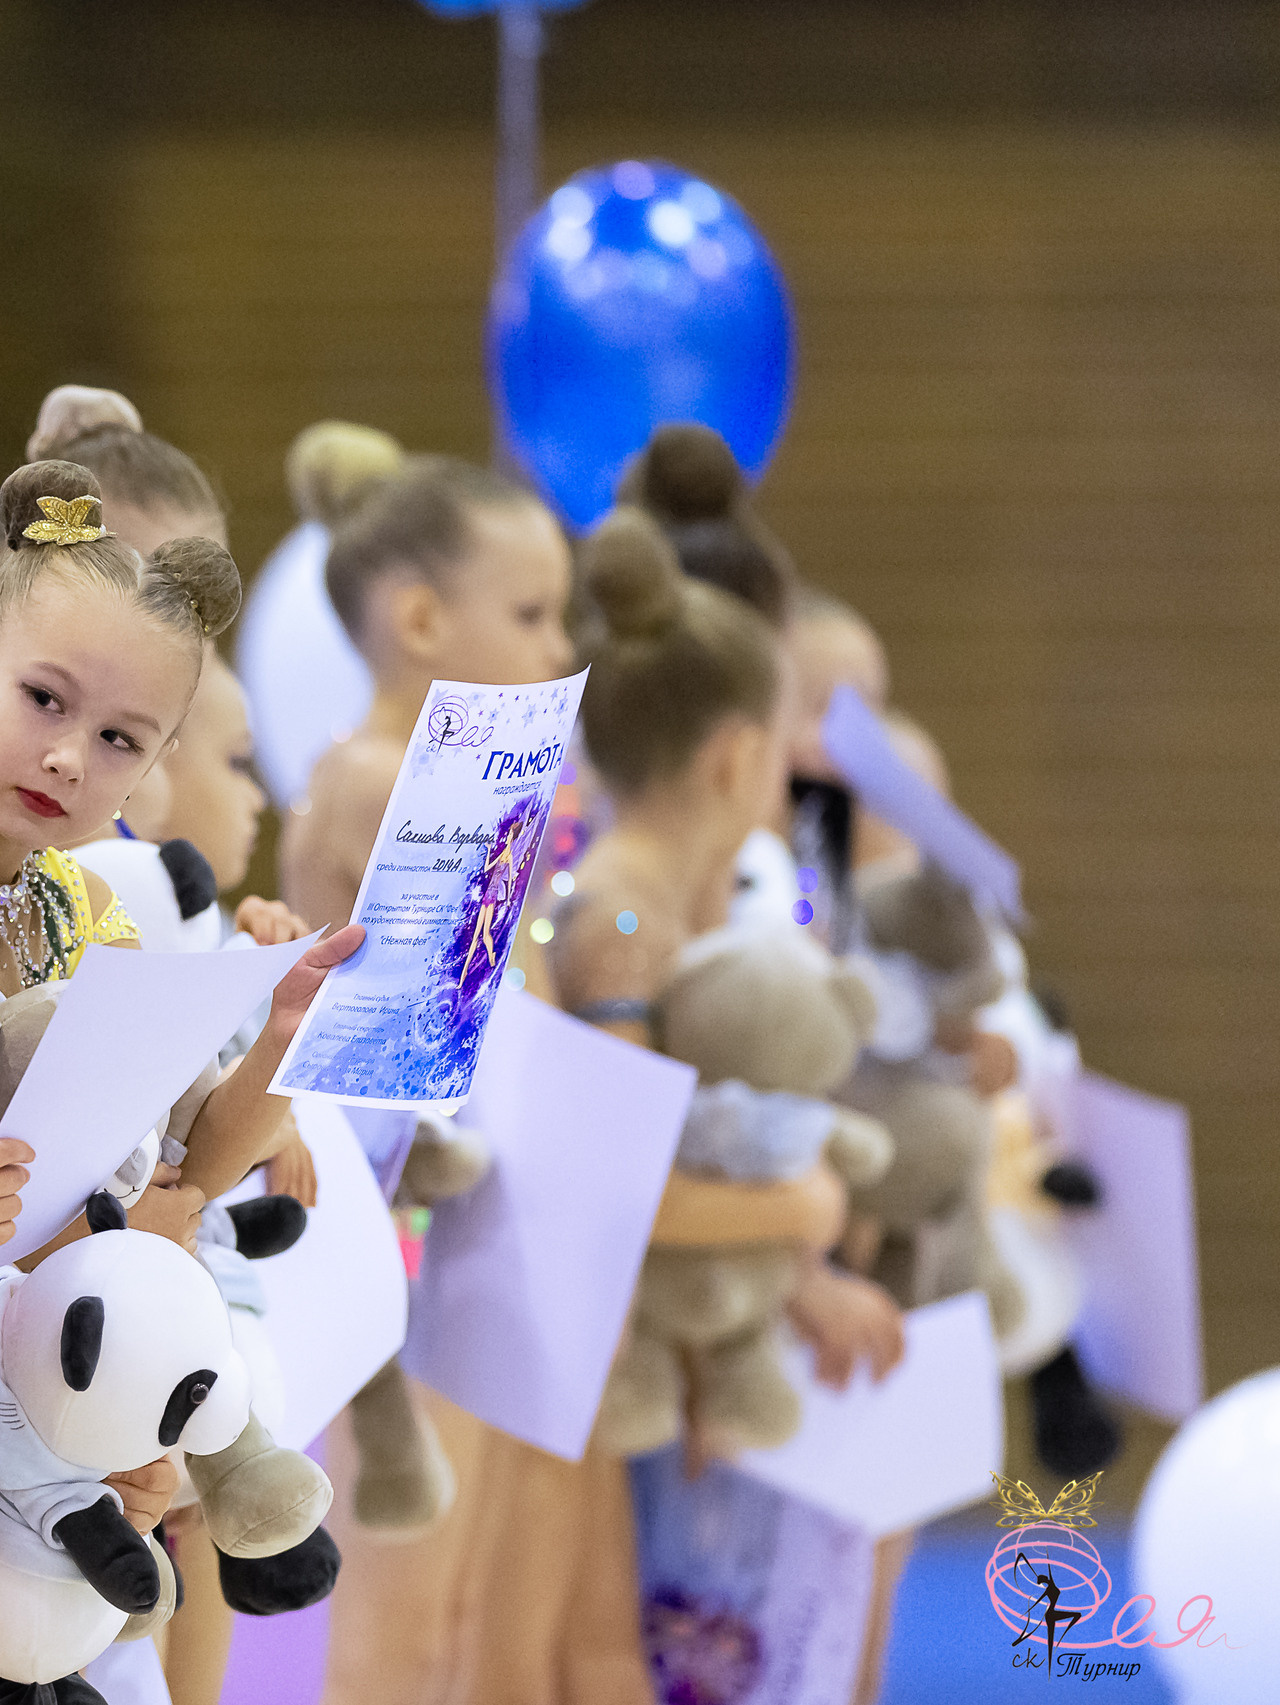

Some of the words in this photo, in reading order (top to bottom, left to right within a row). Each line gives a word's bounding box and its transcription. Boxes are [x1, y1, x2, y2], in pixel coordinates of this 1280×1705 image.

[482, 743, 564, 780] ГРАМОТА
[493, 781, 542, 796] награждается
[376, 862, 396, 872] среди
[407, 893, 435, 902] участие
[374, 902, 410, 913] Открытом
